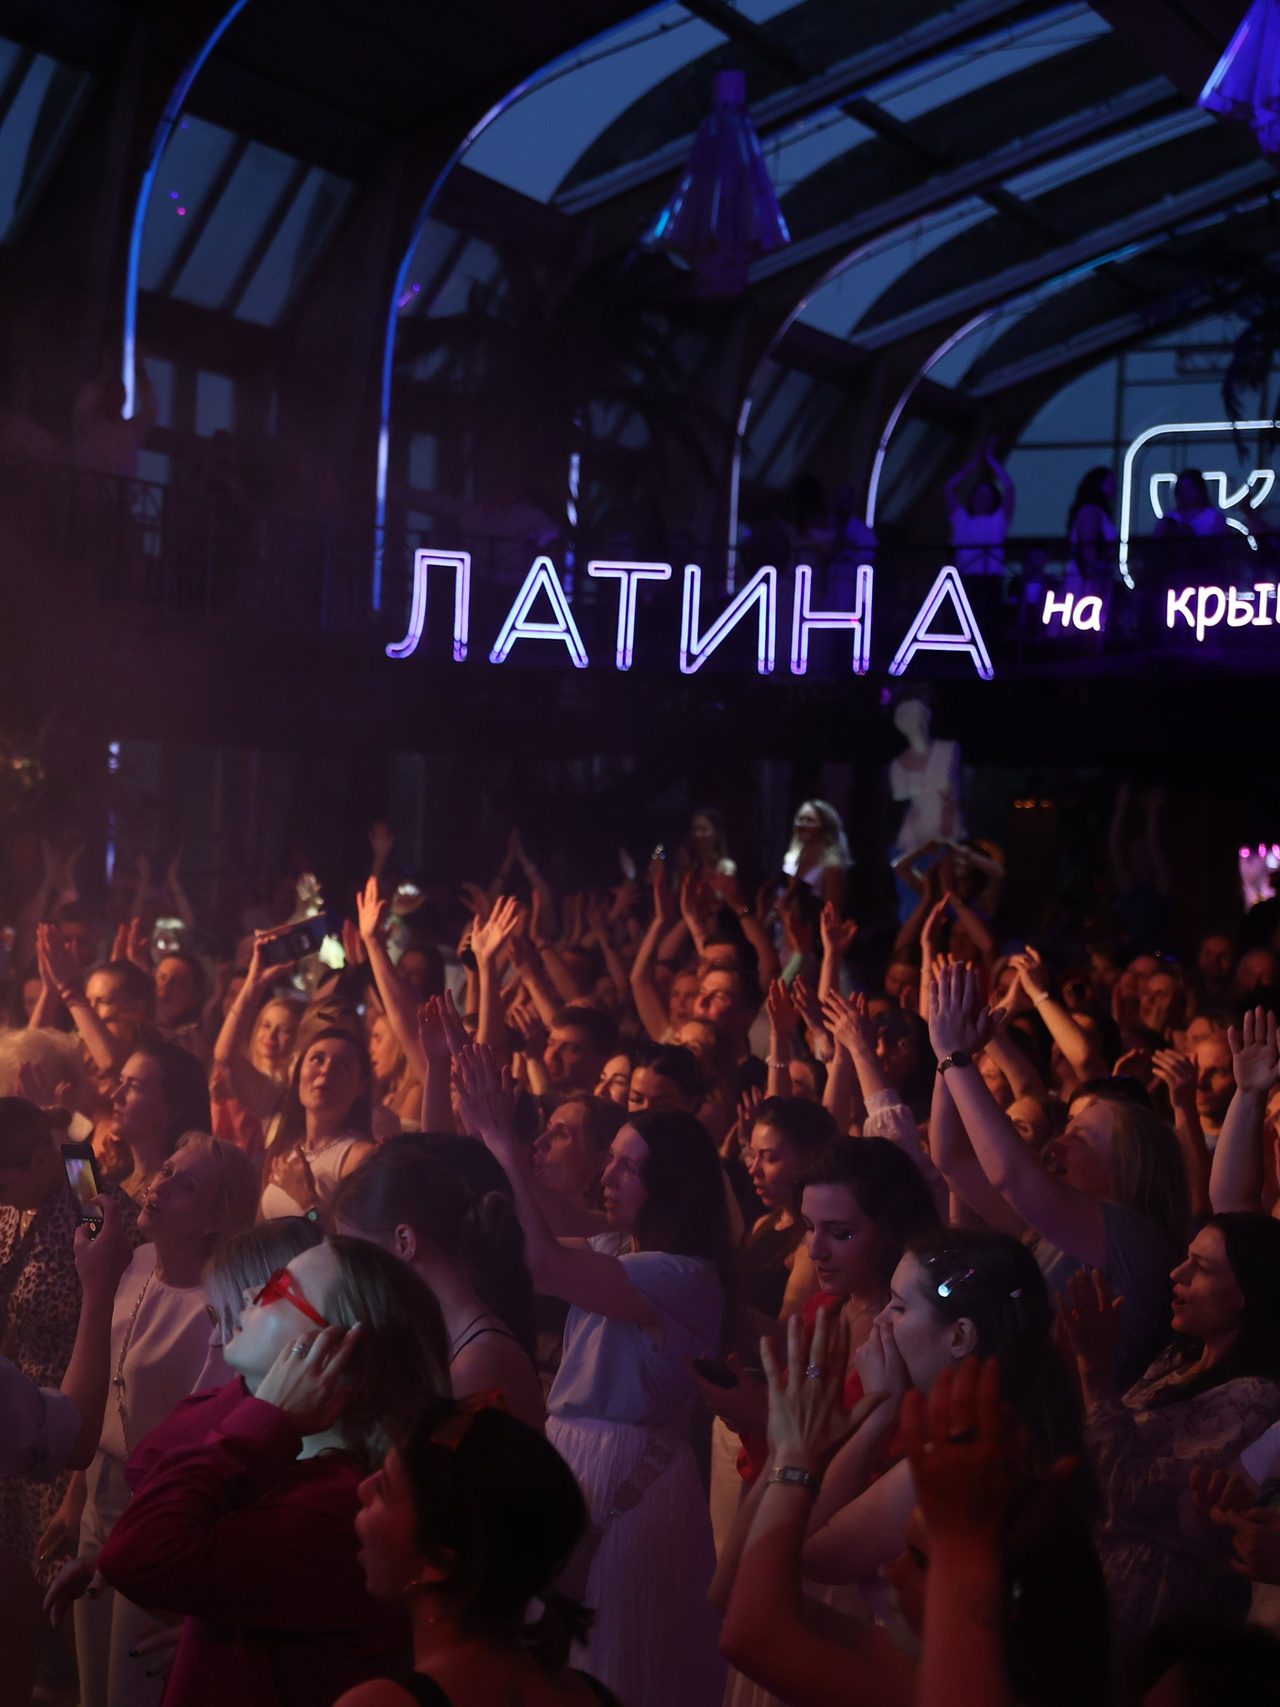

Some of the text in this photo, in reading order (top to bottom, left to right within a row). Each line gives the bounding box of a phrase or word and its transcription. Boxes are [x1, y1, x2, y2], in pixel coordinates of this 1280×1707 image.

[384, 548, 1280, 681] ЛАТИНА на кры
